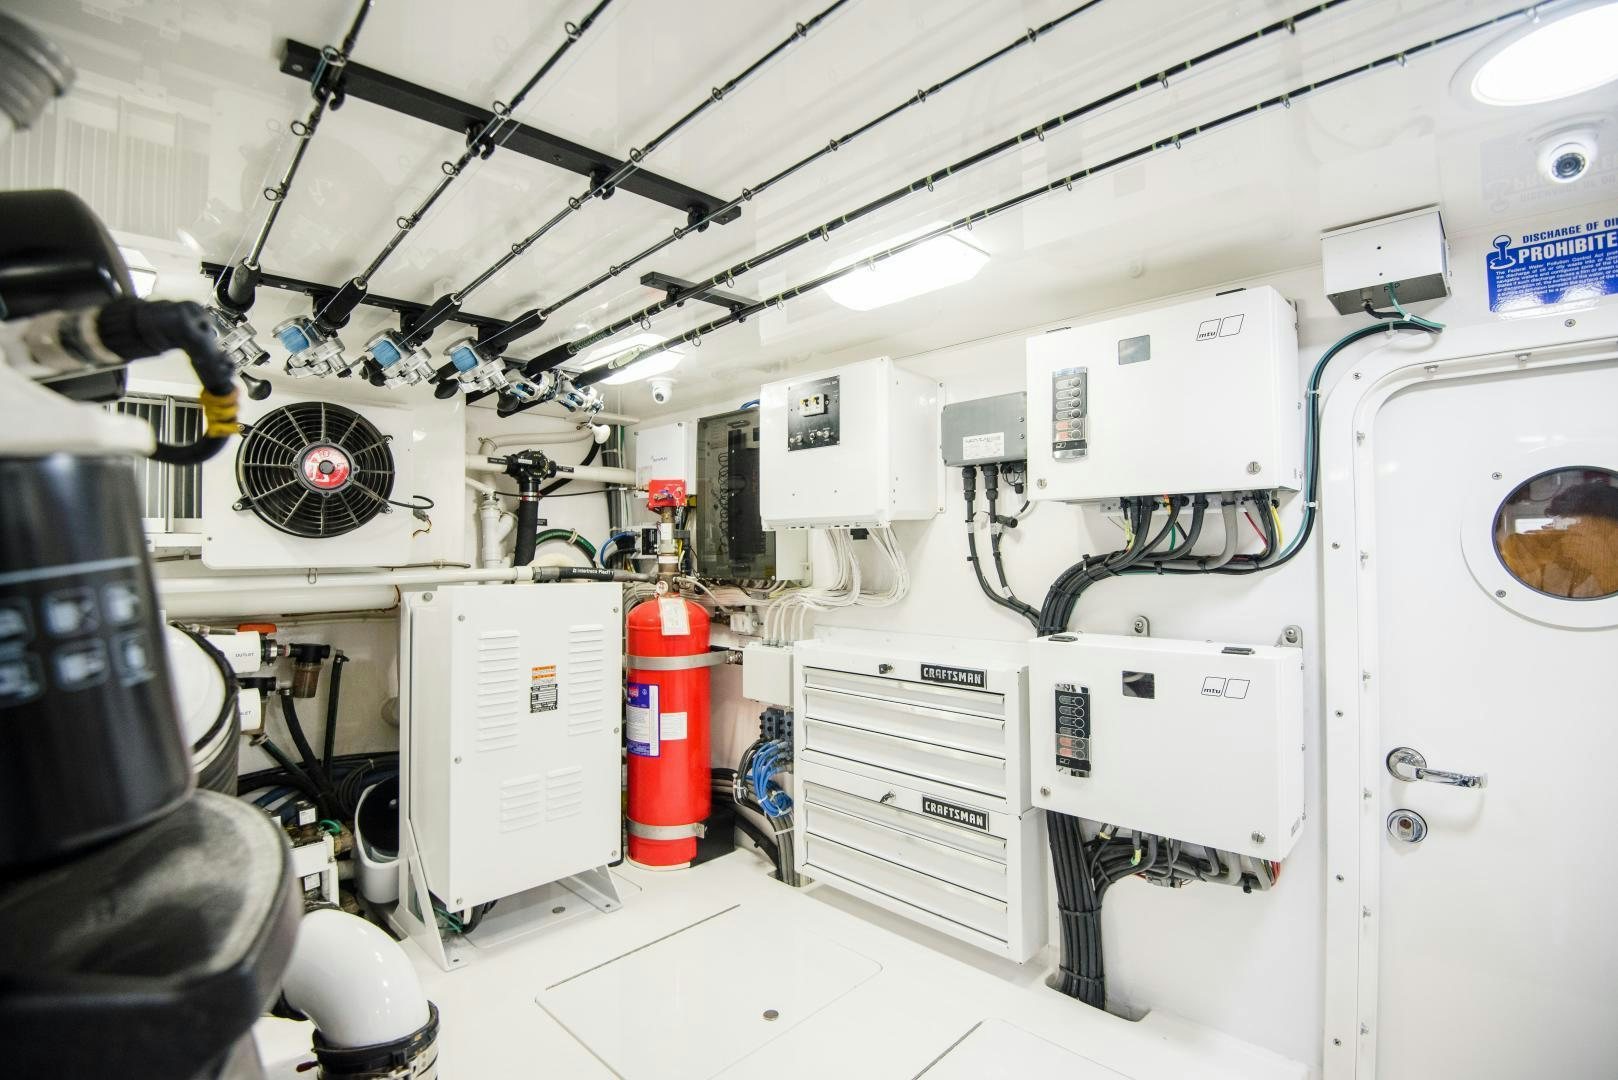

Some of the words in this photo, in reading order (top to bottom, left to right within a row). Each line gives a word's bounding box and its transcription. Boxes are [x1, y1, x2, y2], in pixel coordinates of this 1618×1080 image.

[1523, 225, 1582, 243] DISCHARGE
[1586, 221, 1599, 231] OF
[923, 667, 982, 685] CRAFTSMAN
[925, 800, 984, 826] CRAFTSMAN
